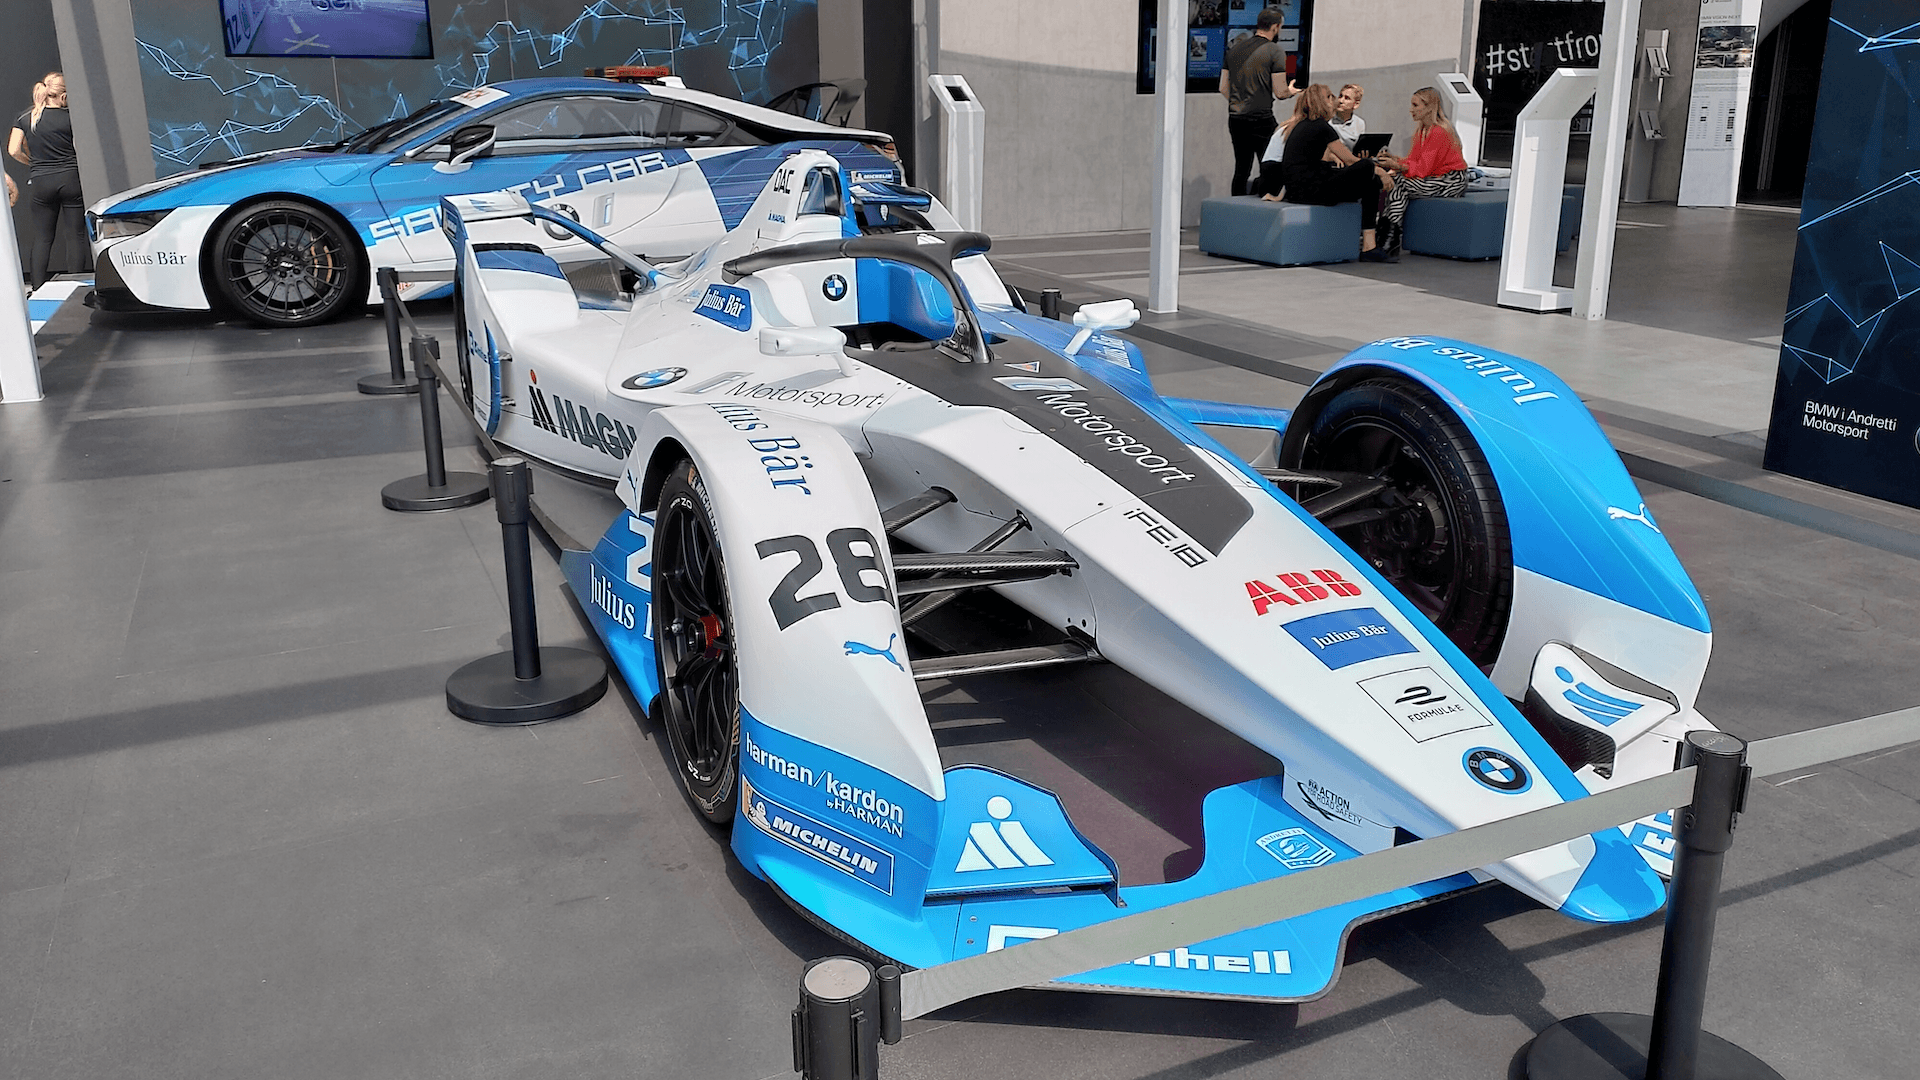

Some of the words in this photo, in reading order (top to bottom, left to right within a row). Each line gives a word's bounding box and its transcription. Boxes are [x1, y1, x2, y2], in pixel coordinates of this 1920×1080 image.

[1486, 30, 1602, 76] #sttfro
[368, 173, 566, 243] SATY
[576, 151, 669, 190] CAR
[120, 251, 154, 267] Julius
[159, 251, 187, 266] Bär
[698, 288, 726, 311] Julius
[723, 293, 746, 318] Bär
[724, 380, 884, 409] Motorsport
[1432, 346, 1560, 407] Julius
[552, 394, 638, 461] MAGN
[1036, 392, 1196, 485] Motorsport
[1802, 414, 1870, 441] Motorsport
[1804, 400, 1841, 419] BMW
[1840, 407, 1846, 421] i
[1846, 409, 1898, 432] Andretti
[746, 435, 815, 496] Bär
[626, 515, 655, 593] 2
[589, 562, 636, 630] Julius
[754, 527, 897, 632] 28
[1244, 568, 1363, 617] ABB
[1311, 628, 1361, 650] Julius
[1357, 625, 1389, 638] Bär
[834, 798, 904, 839] HARMAN
[1316, 793, 1335, 811] ROAD
[1335, 804, 1363, 825] SAFETY
[1320, 786, 1350, 811] ACTION
[771, 815, 880, 875] MICHELIN
